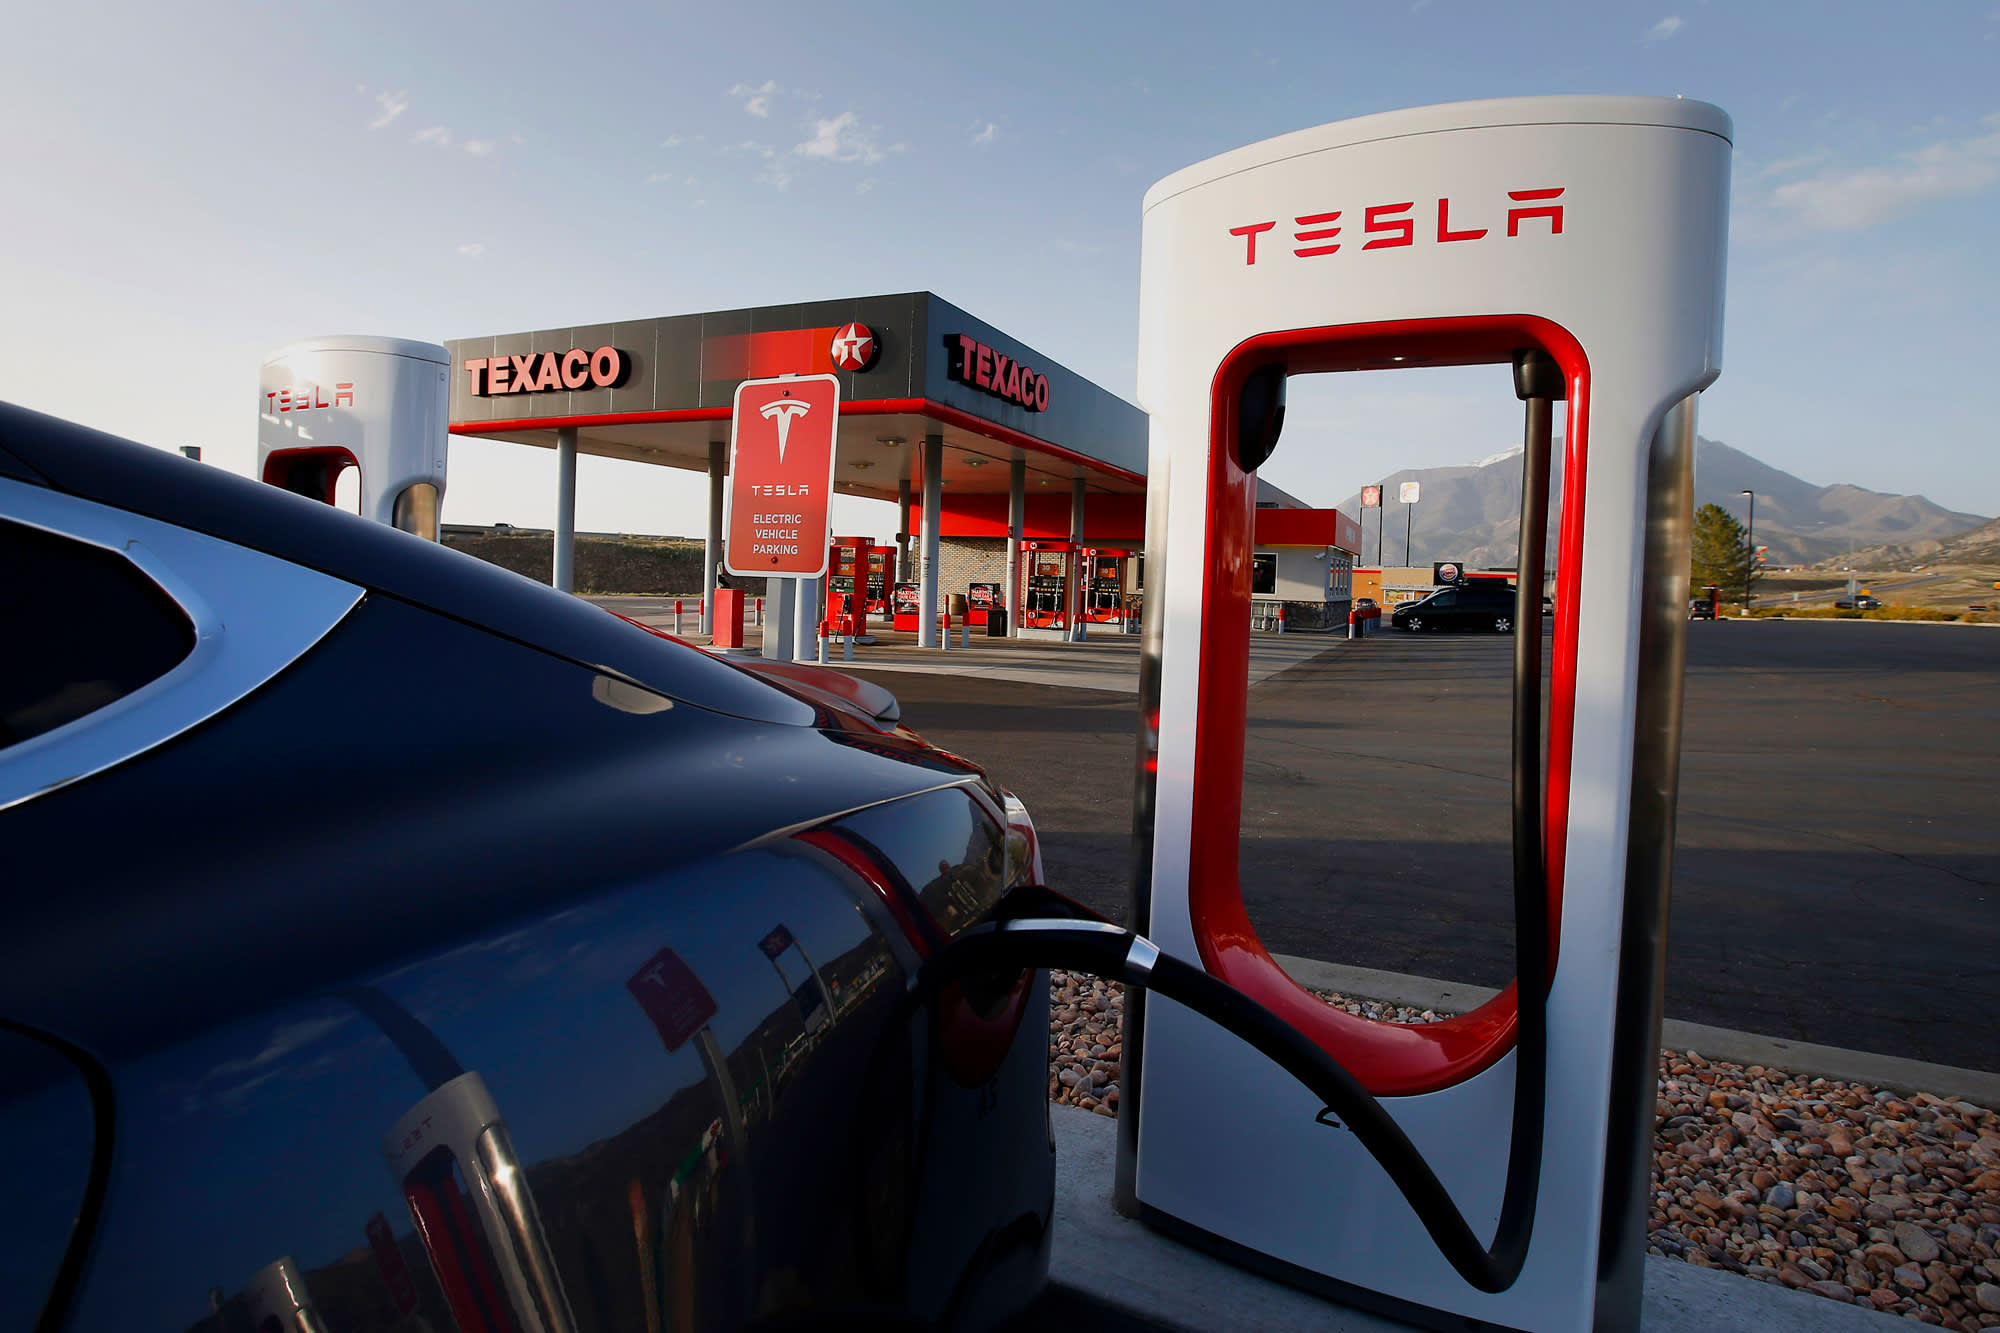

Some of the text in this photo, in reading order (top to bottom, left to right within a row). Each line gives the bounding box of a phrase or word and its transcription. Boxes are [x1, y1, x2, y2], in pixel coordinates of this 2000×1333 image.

[1229, 187, 1564, 266] TESLA
[464, 345, 620, 395] TEXACO
[959, 334, 1049, 413] TEXACO
[266, 382, 354, 414] TESLA
[751, 484, 809, 497] TESLA
[753, 513, 802, 525] ELECTRIC
[755, 529, 798, 540] VEHICLE
[752, 544, 799, 556] PARKING
